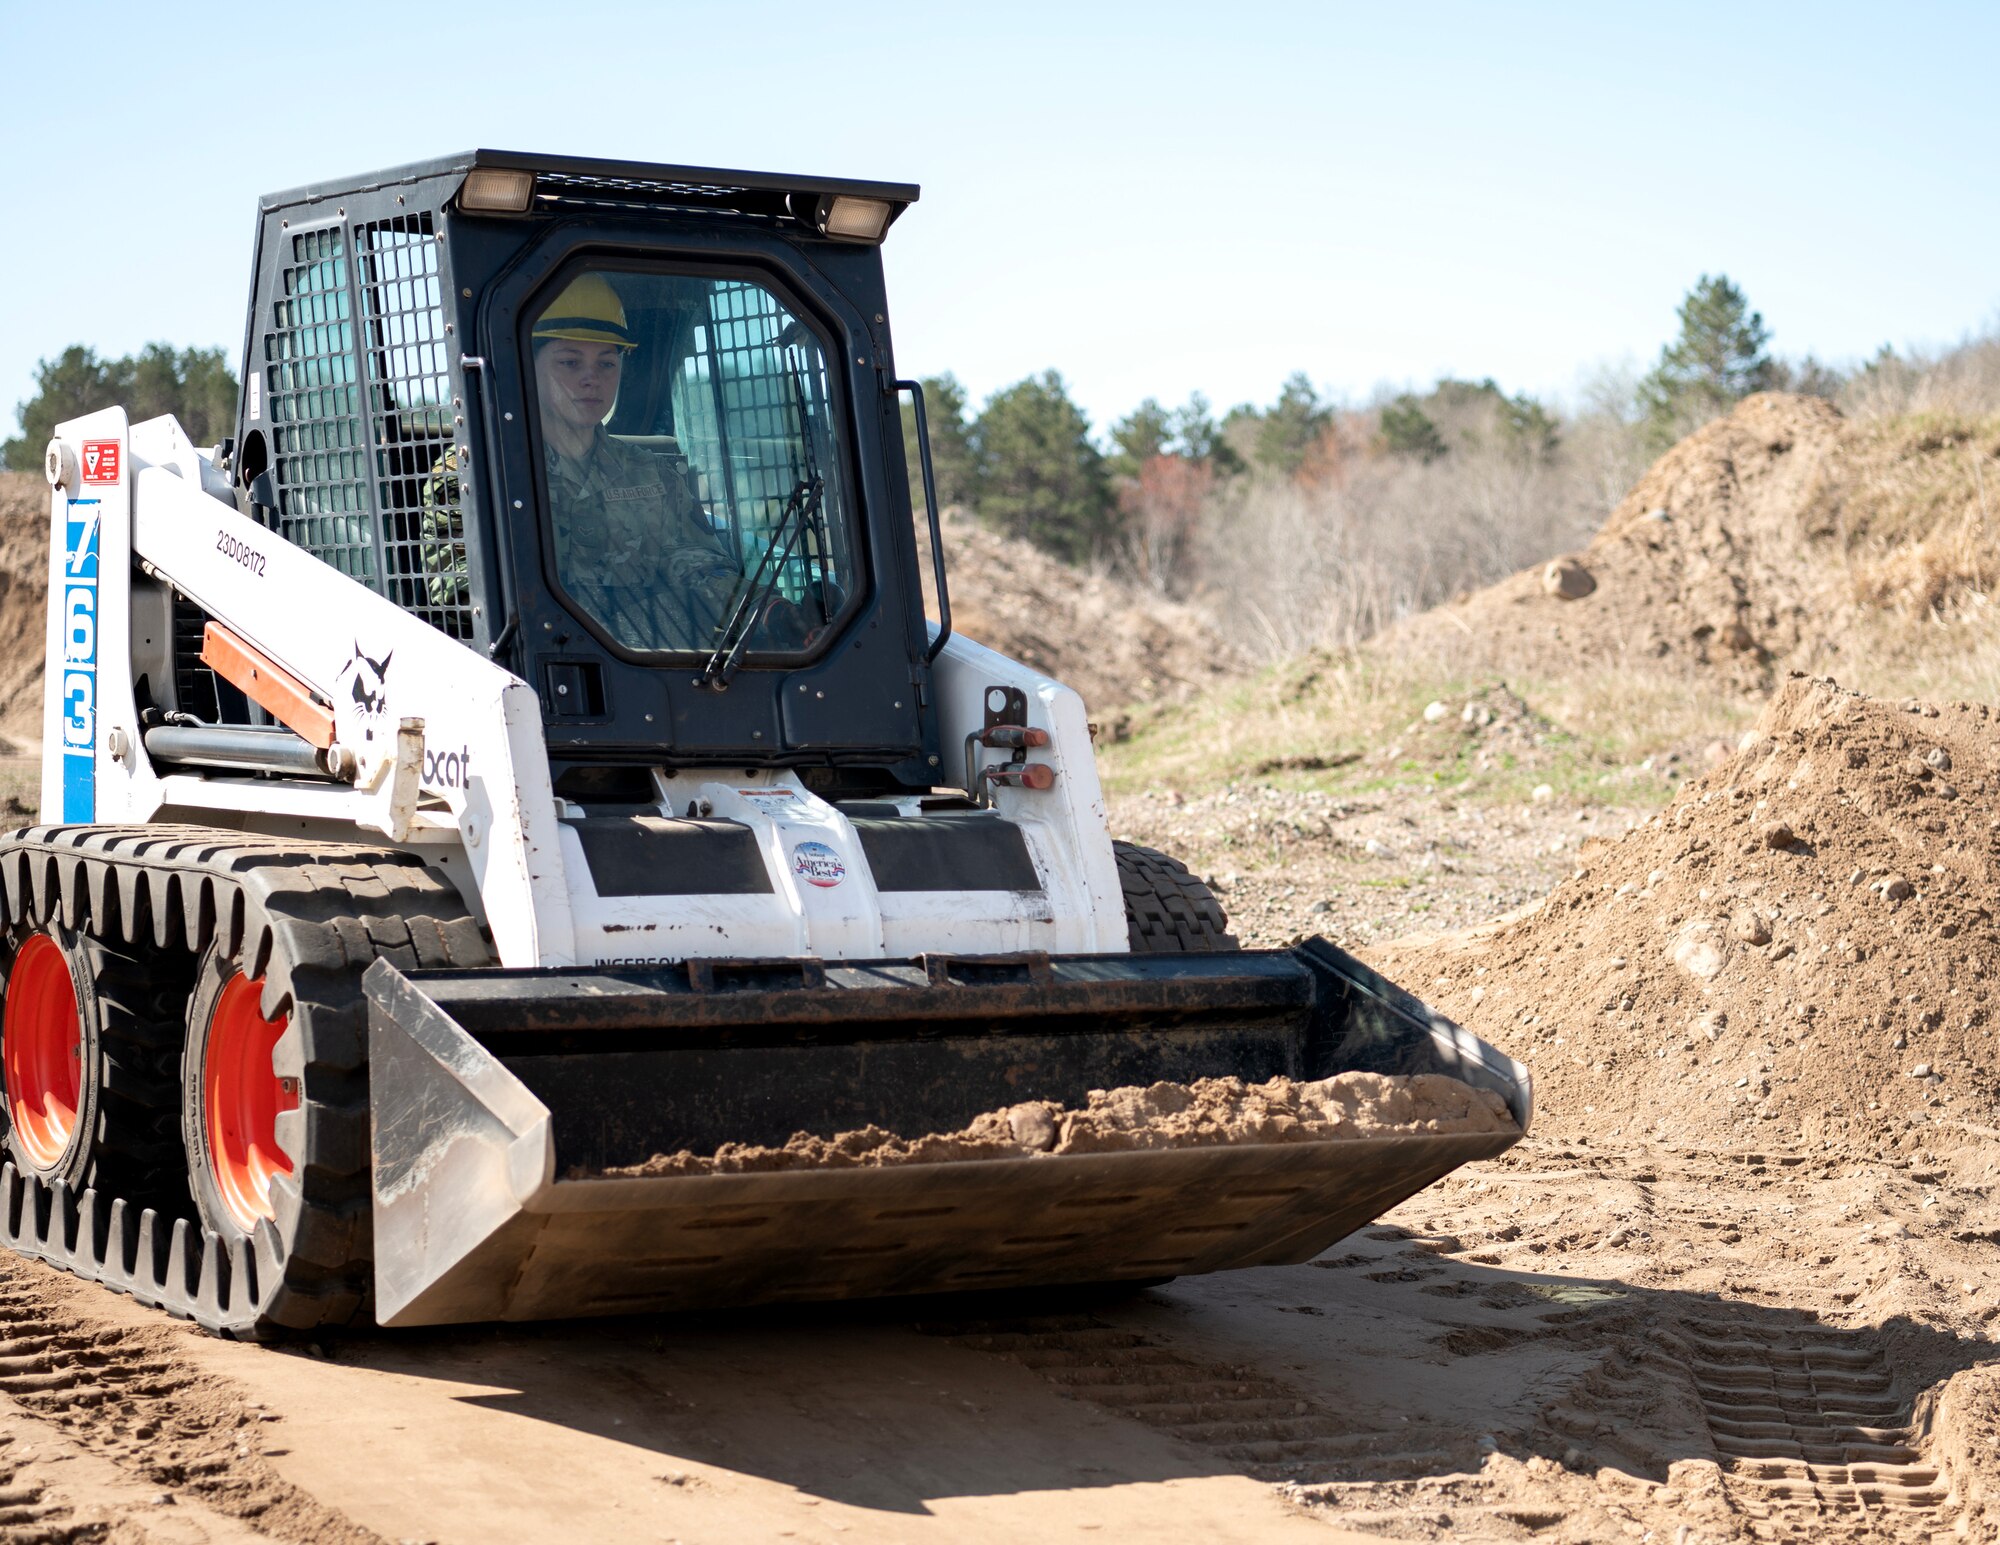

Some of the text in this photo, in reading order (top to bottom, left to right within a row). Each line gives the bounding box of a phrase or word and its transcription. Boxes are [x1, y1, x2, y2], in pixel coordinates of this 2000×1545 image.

[635, 484, 663, 497] FORCE
[216, 529, 266, 578] 23D08172
[64, 503, 99, 746] 763
[421, 744, 470, 790] bcat
[796, 856, 842, 868] America's
[810, 866, 832, 877] Best
[594, 957, 684, 966] INGERSO
